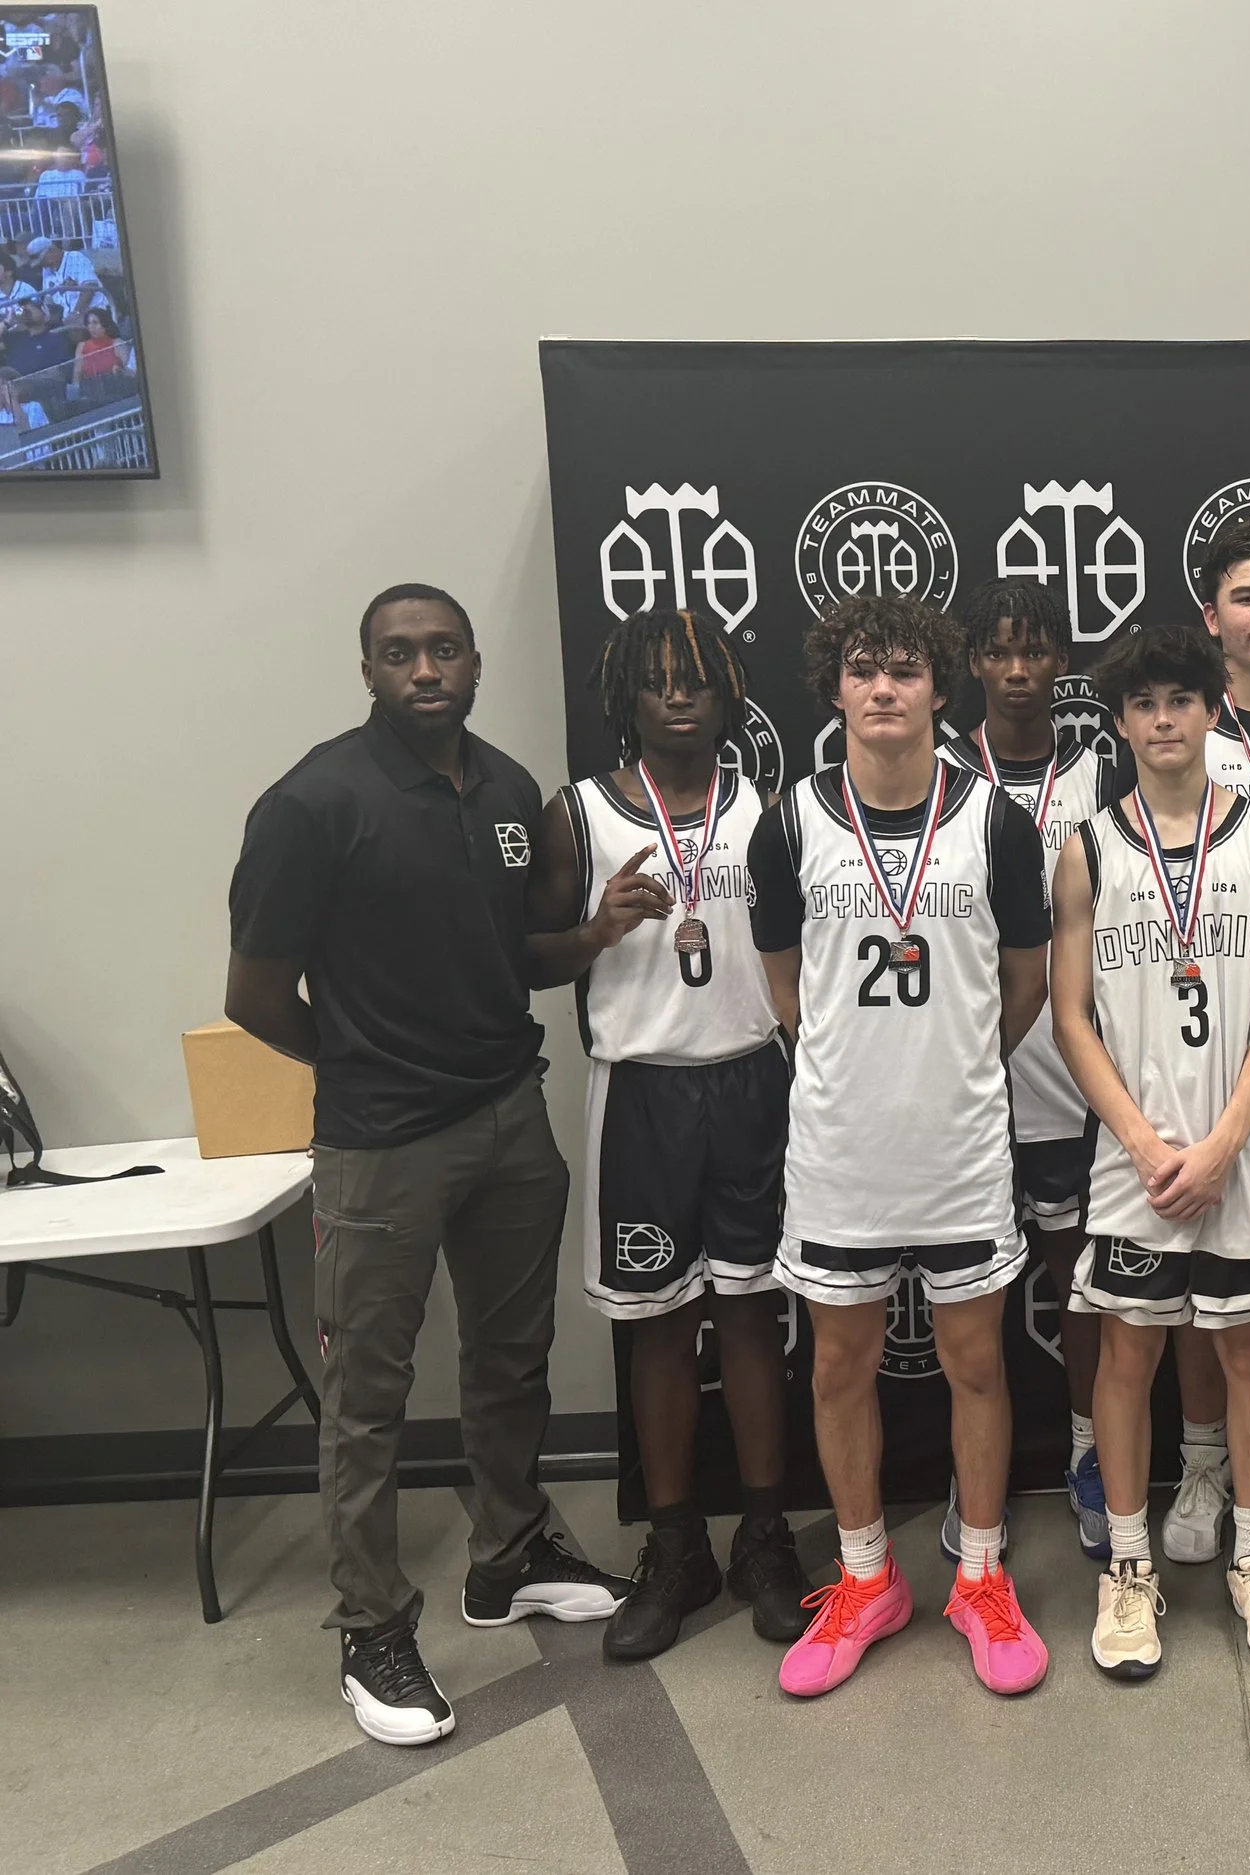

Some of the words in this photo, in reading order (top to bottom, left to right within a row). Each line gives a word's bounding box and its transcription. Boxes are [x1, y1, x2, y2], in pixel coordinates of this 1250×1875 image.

[803, 489, 947, 550] TEAMMATE
[840, 859, 864, 868] CHS
[1130, 890, 1155, 902] CHS
[1212, 882, 1237, 893] USA
[677, 919, 713, 987] 0
[857, 934, 931, 1007] 20
[1178, 979, 1210, 1047] 3
